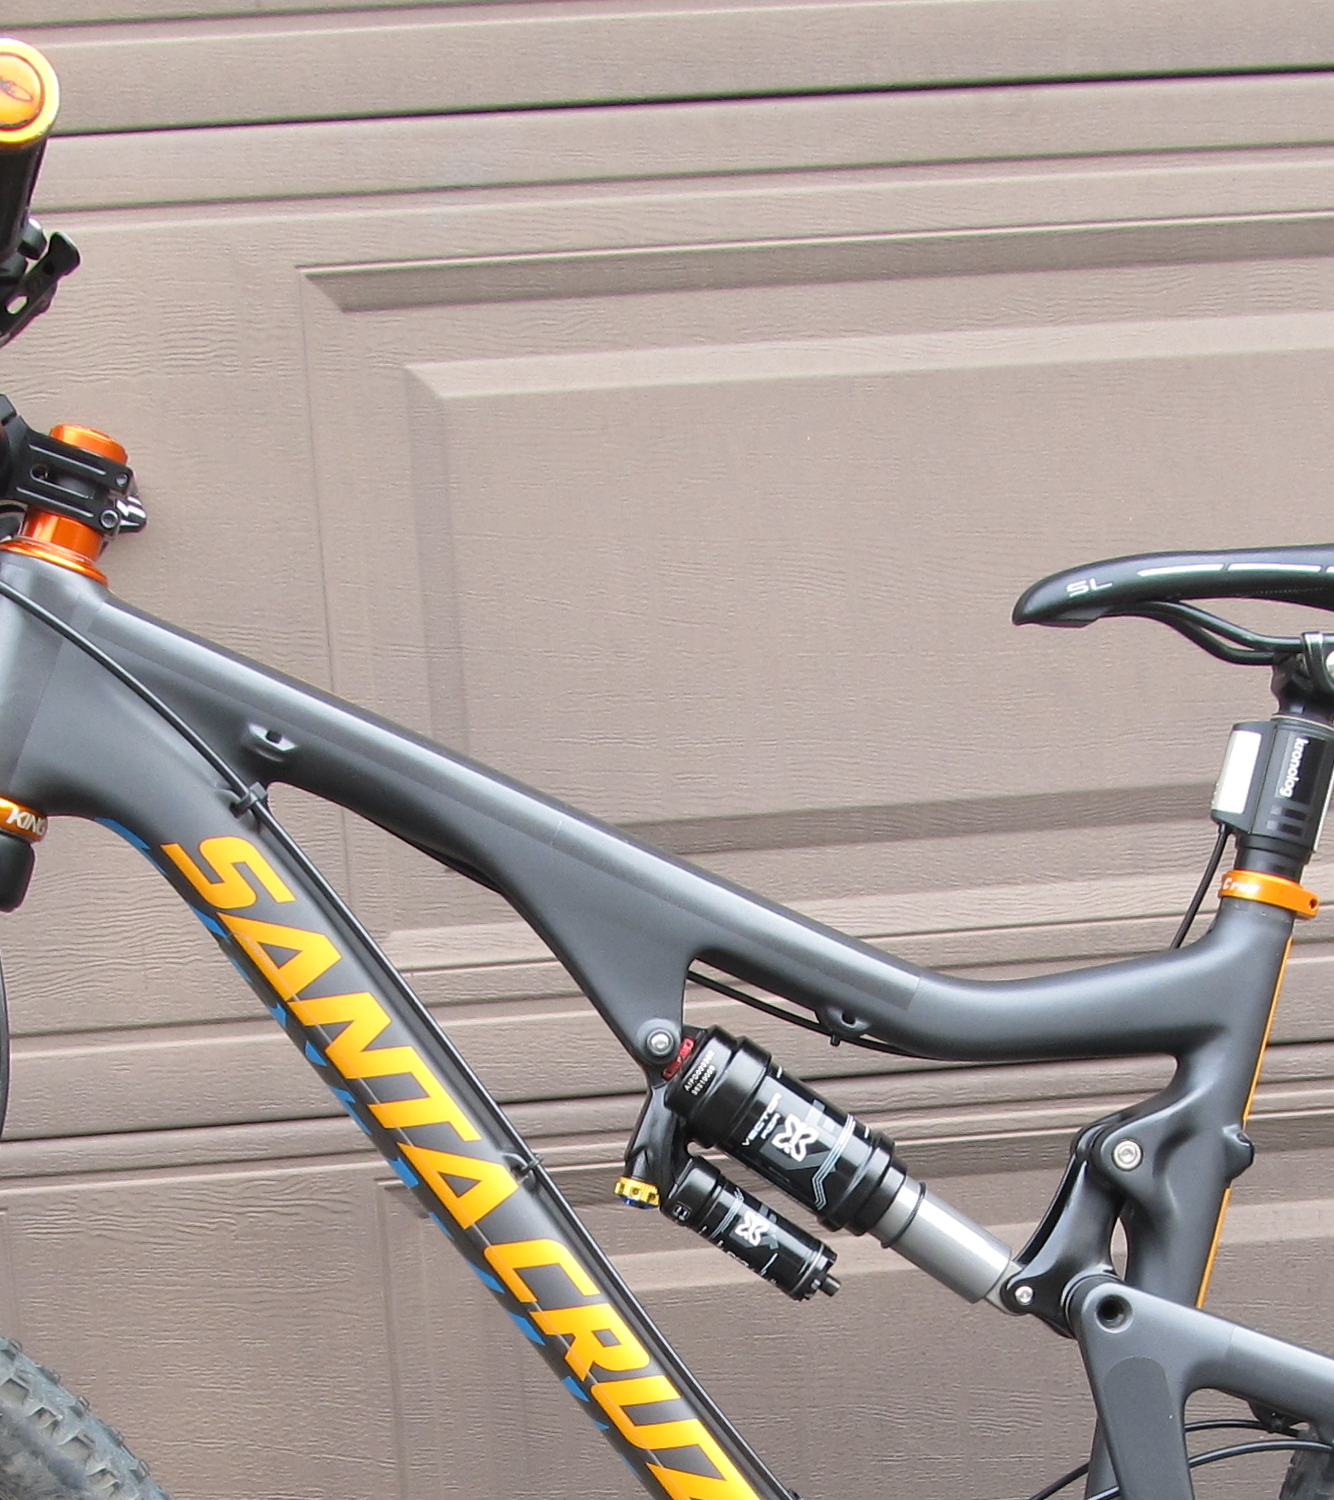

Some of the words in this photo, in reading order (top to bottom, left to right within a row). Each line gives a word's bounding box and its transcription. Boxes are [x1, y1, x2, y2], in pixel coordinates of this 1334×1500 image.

[1066, 577, 1114, 598] SL
[1279, 737, 1309, 798] kronolog
[6, 807, 48, 836] KING
[161, 835, 519, 1230] SANTA
